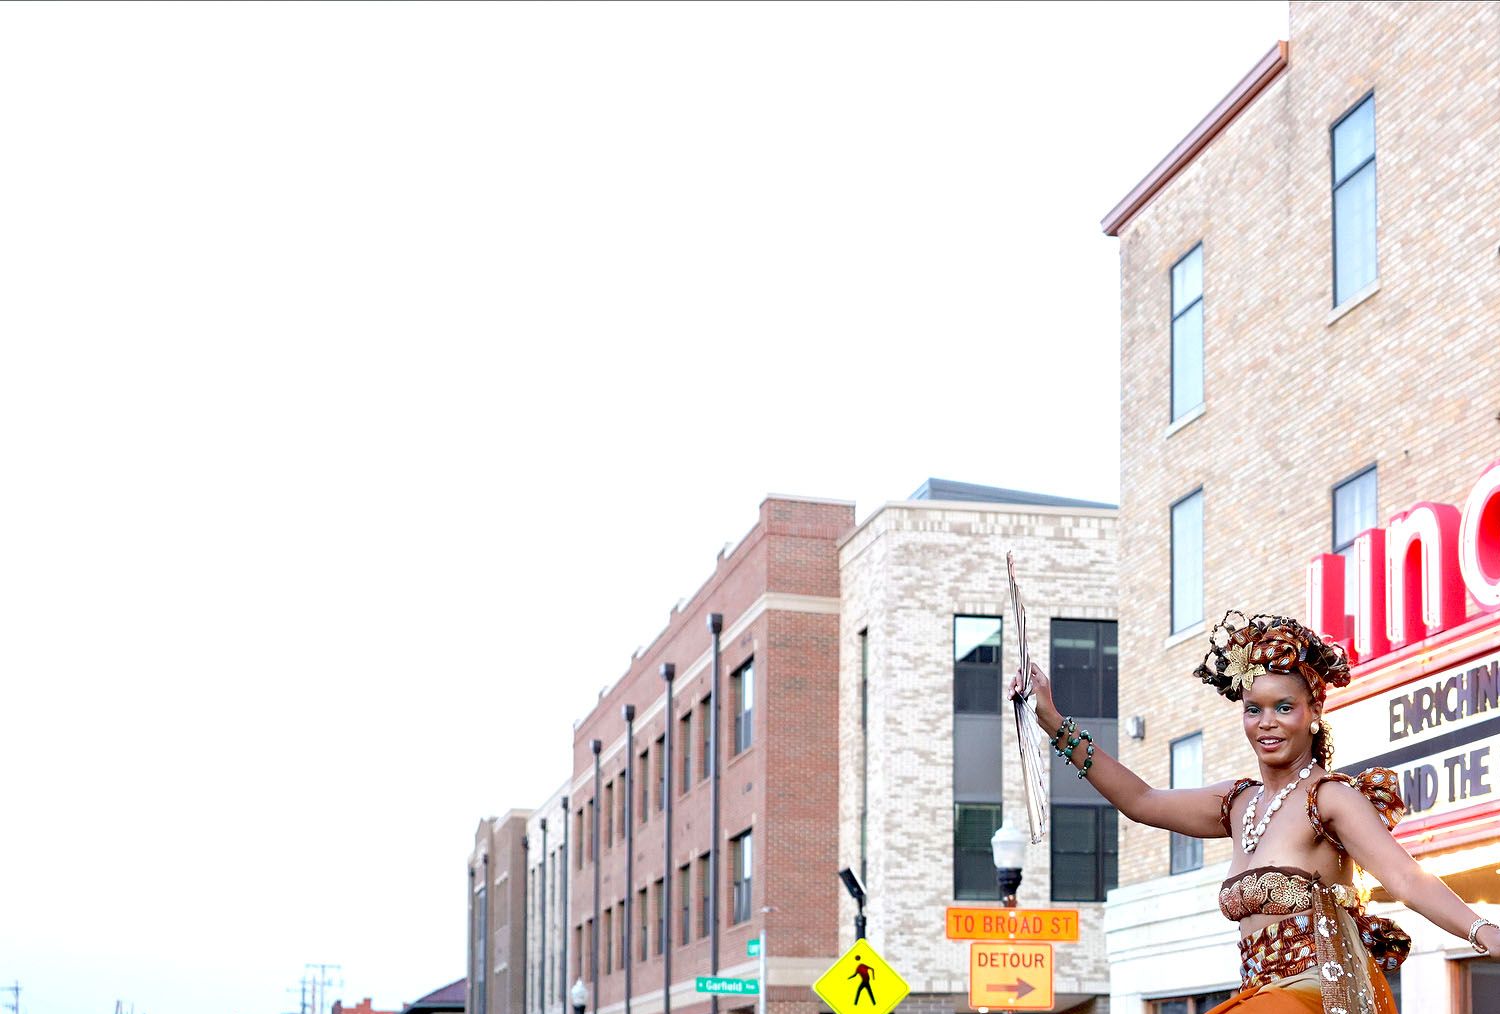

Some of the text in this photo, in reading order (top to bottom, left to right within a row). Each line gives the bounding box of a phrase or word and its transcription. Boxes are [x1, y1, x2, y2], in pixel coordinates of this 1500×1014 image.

[1396, 763, 1438, 815] ND
[1444, 746, 1491, 802] THE
[953, 915, 1073, 935] TO BROAD ST
[978, 952, 1045, 968] DETOUR
